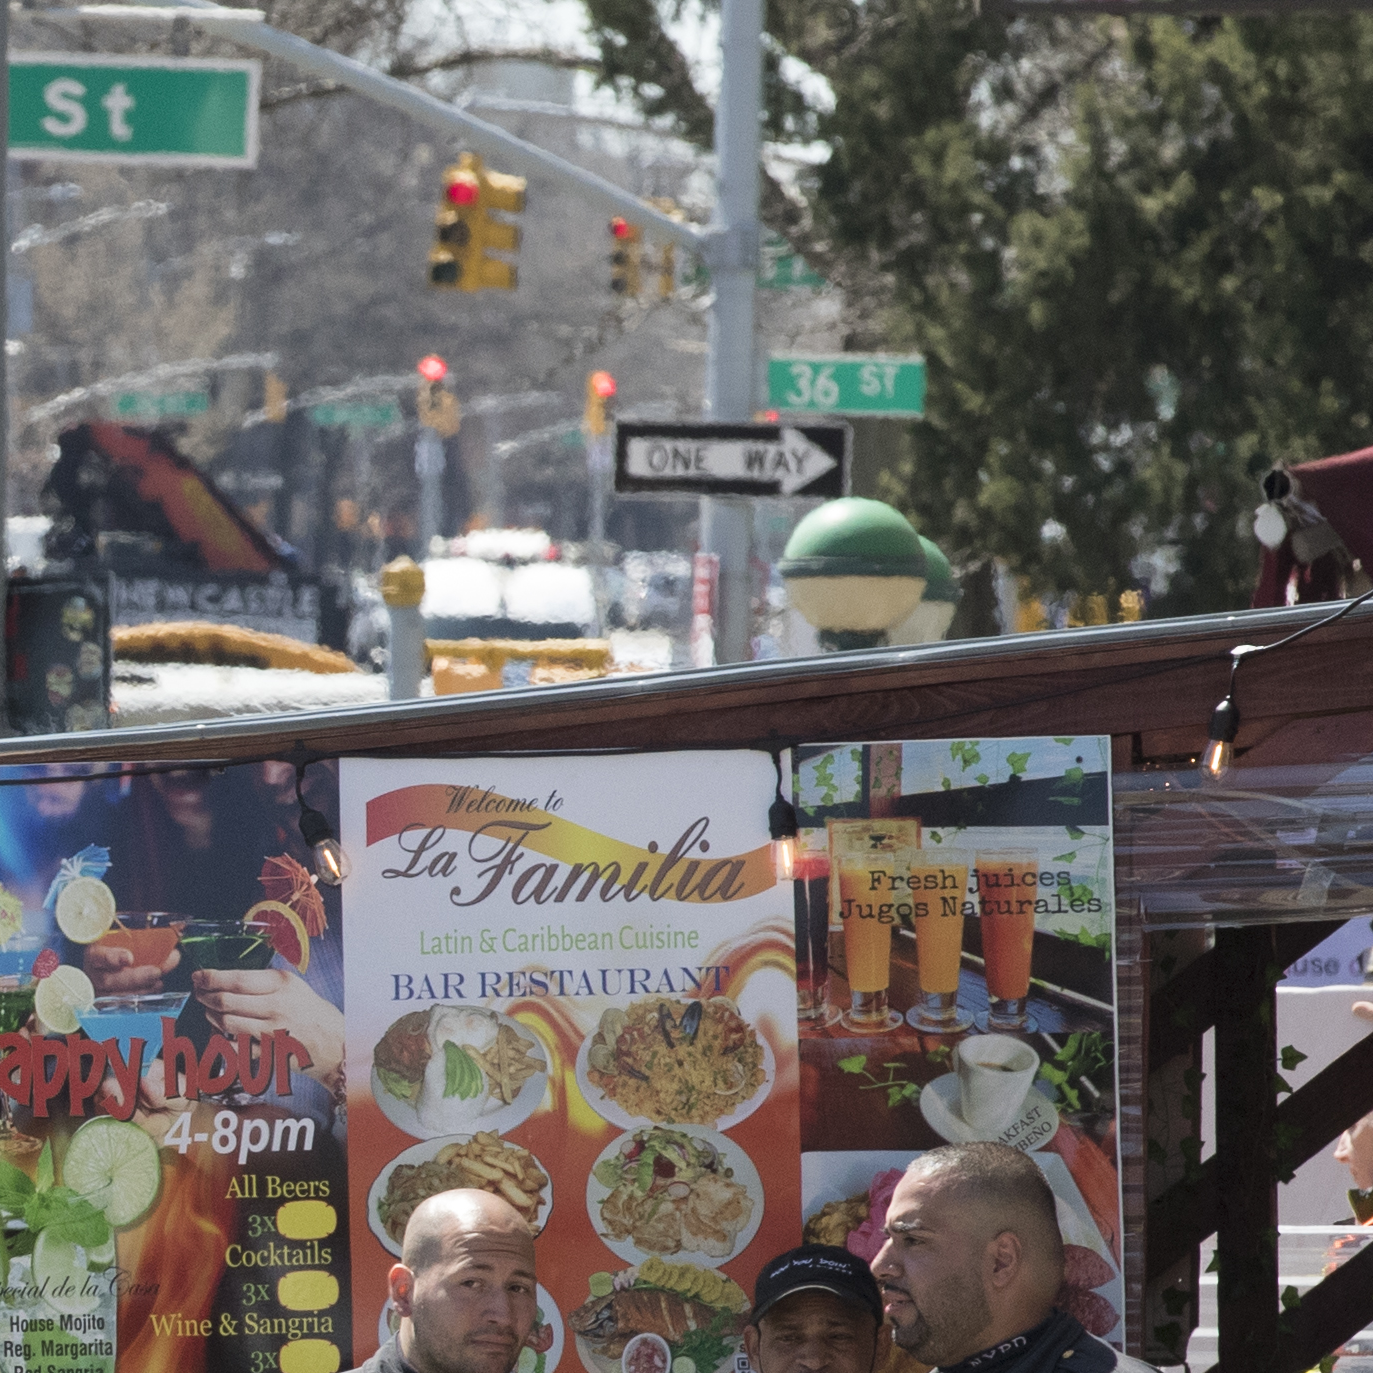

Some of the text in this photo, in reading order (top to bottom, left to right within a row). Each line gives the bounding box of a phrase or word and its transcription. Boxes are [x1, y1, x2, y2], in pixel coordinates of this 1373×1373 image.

[40, 77, 136, 143] St
[786, 363, 901, 409] 36 ST
[646, 447, 807, 473] ONE WAY
[444, 784, 565, 815] Welcome to
[382, 816, 751, 907] La Familia
[867, 867, 1072, 894] Fresh juices
[838, 894, 1104, 924] Jugos Naturales
[419, 923, 700, 956] Latin & Caribbean Cuisine
[390, 965, 730, 1002] BAR RESTAURANT
[160, 1016, 315, 1101] hour
[163, 1109, 316, 1165] 4-8pm
[224, 1174, 331, 1200] All Beers
[224, 1241, 333, 1269] Cocktails
[51, 1275, 76, 1299] de
[79, 1275, 100, 1298] la
[9, 1314, 105, 1335] House Mojito
[149, 1310, 334, 1342] Wine & Sangria
[3, 1338, 114, 1361] Reg. Margarita
